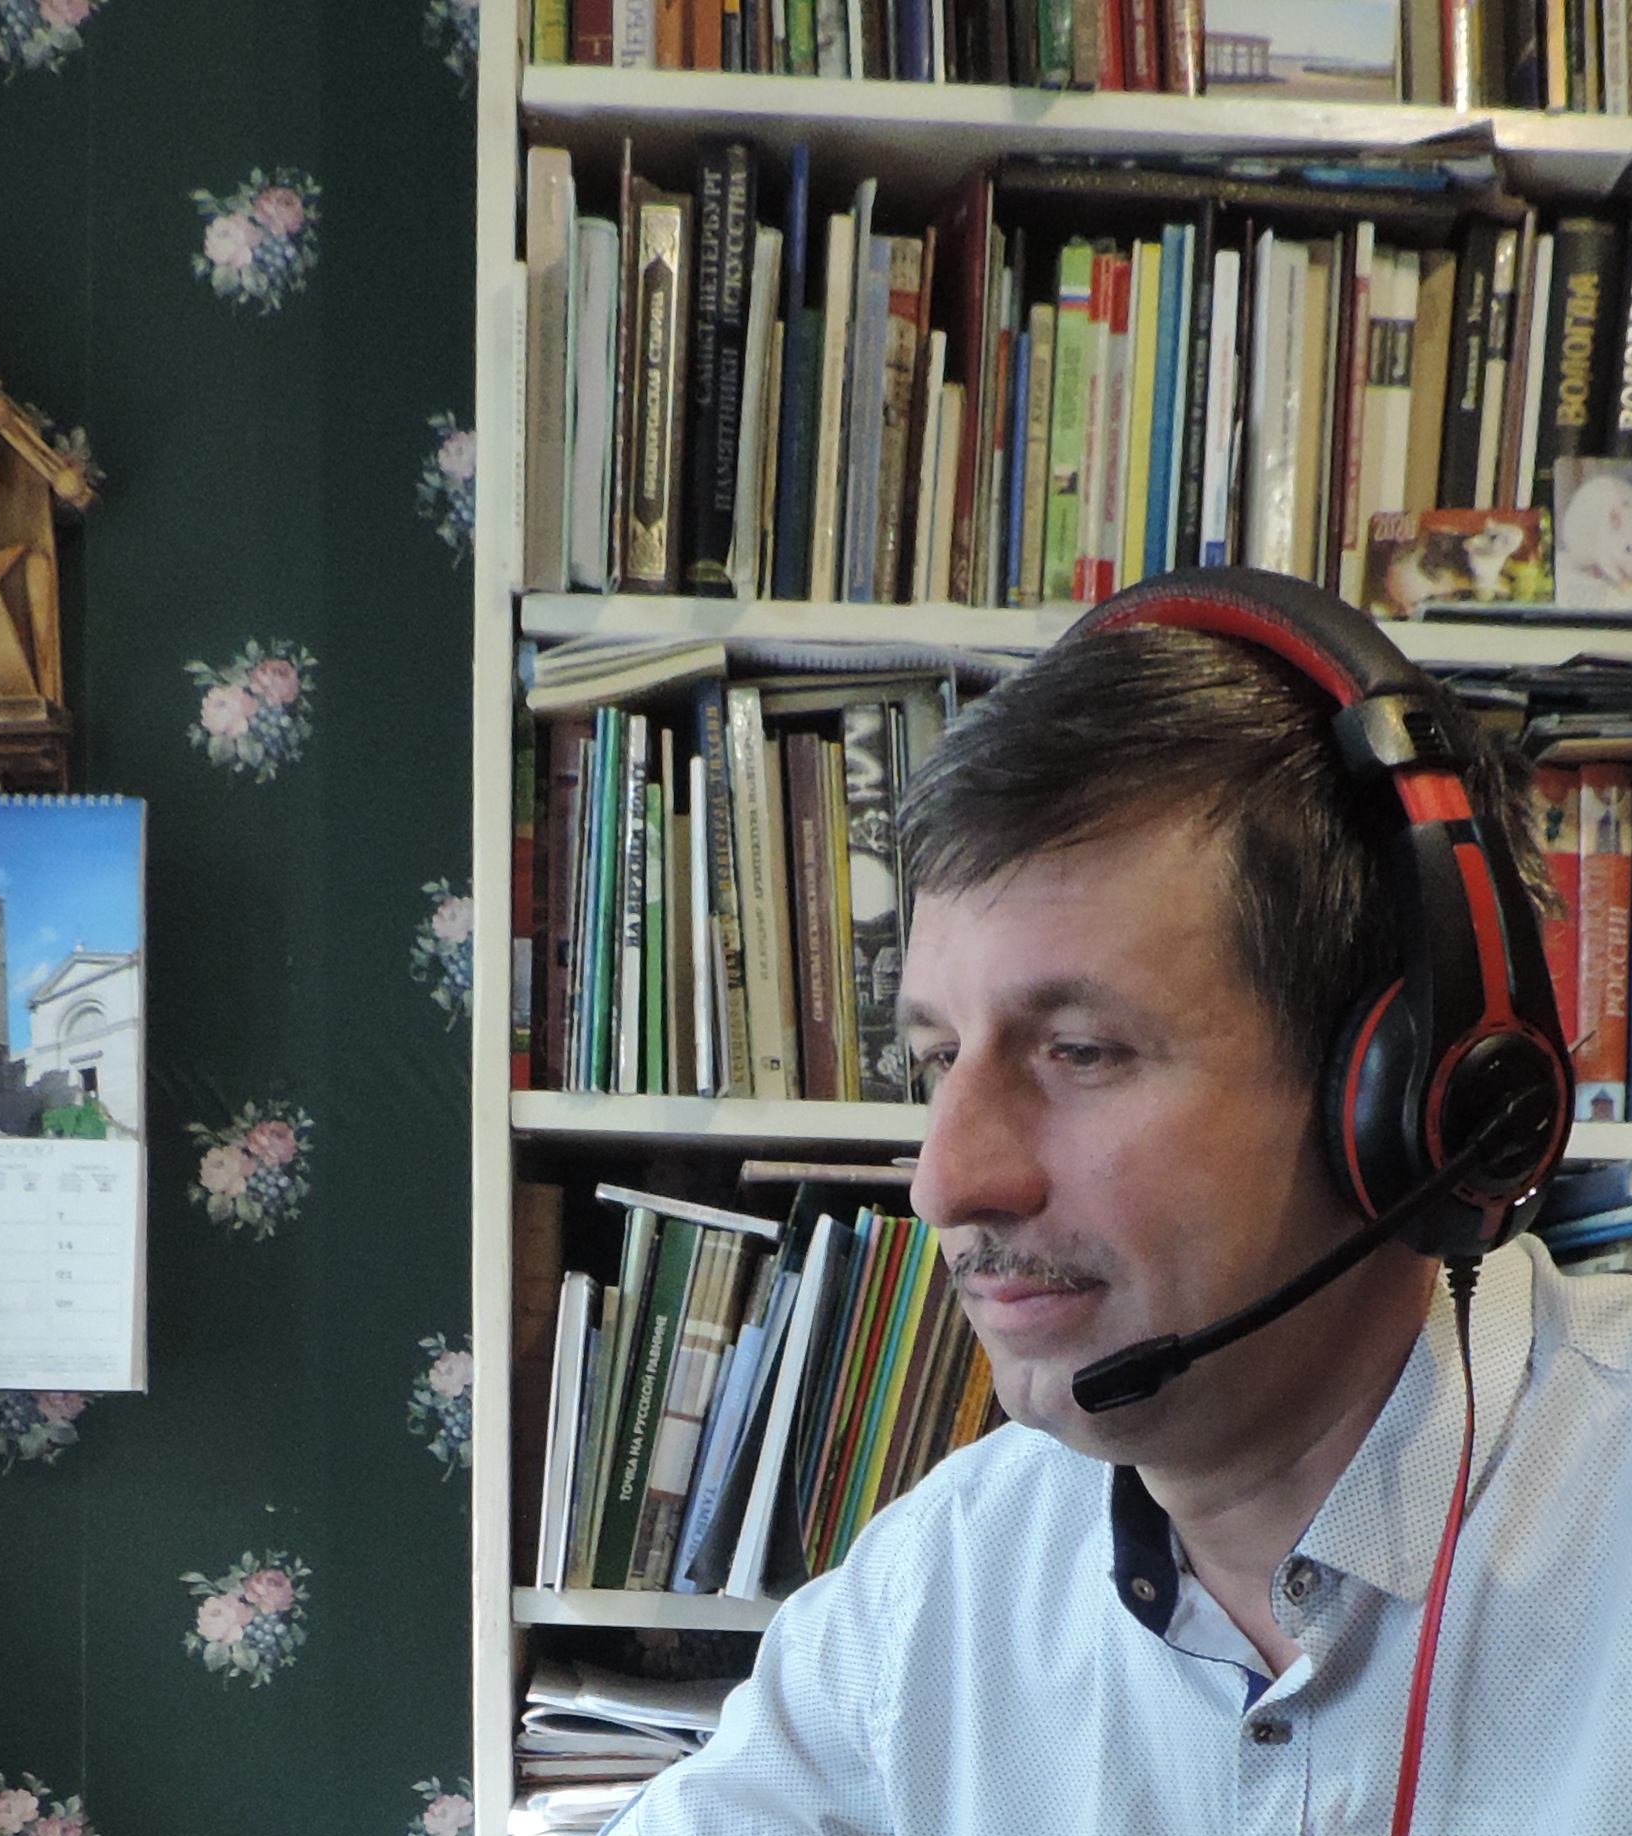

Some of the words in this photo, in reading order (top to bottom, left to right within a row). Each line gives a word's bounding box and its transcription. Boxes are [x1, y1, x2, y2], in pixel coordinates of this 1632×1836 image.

[696, 166, 724, 406] САНКТ-ПЕТЕРБУРГ
[1555, 272, 1600, 427] ВОЛОГДА
[632, 1374, 655, 1435] РУССКОЙ
[628, 1436, 644, 1457] НА
[618, 1458, 639, 1502] ТОЧКА
